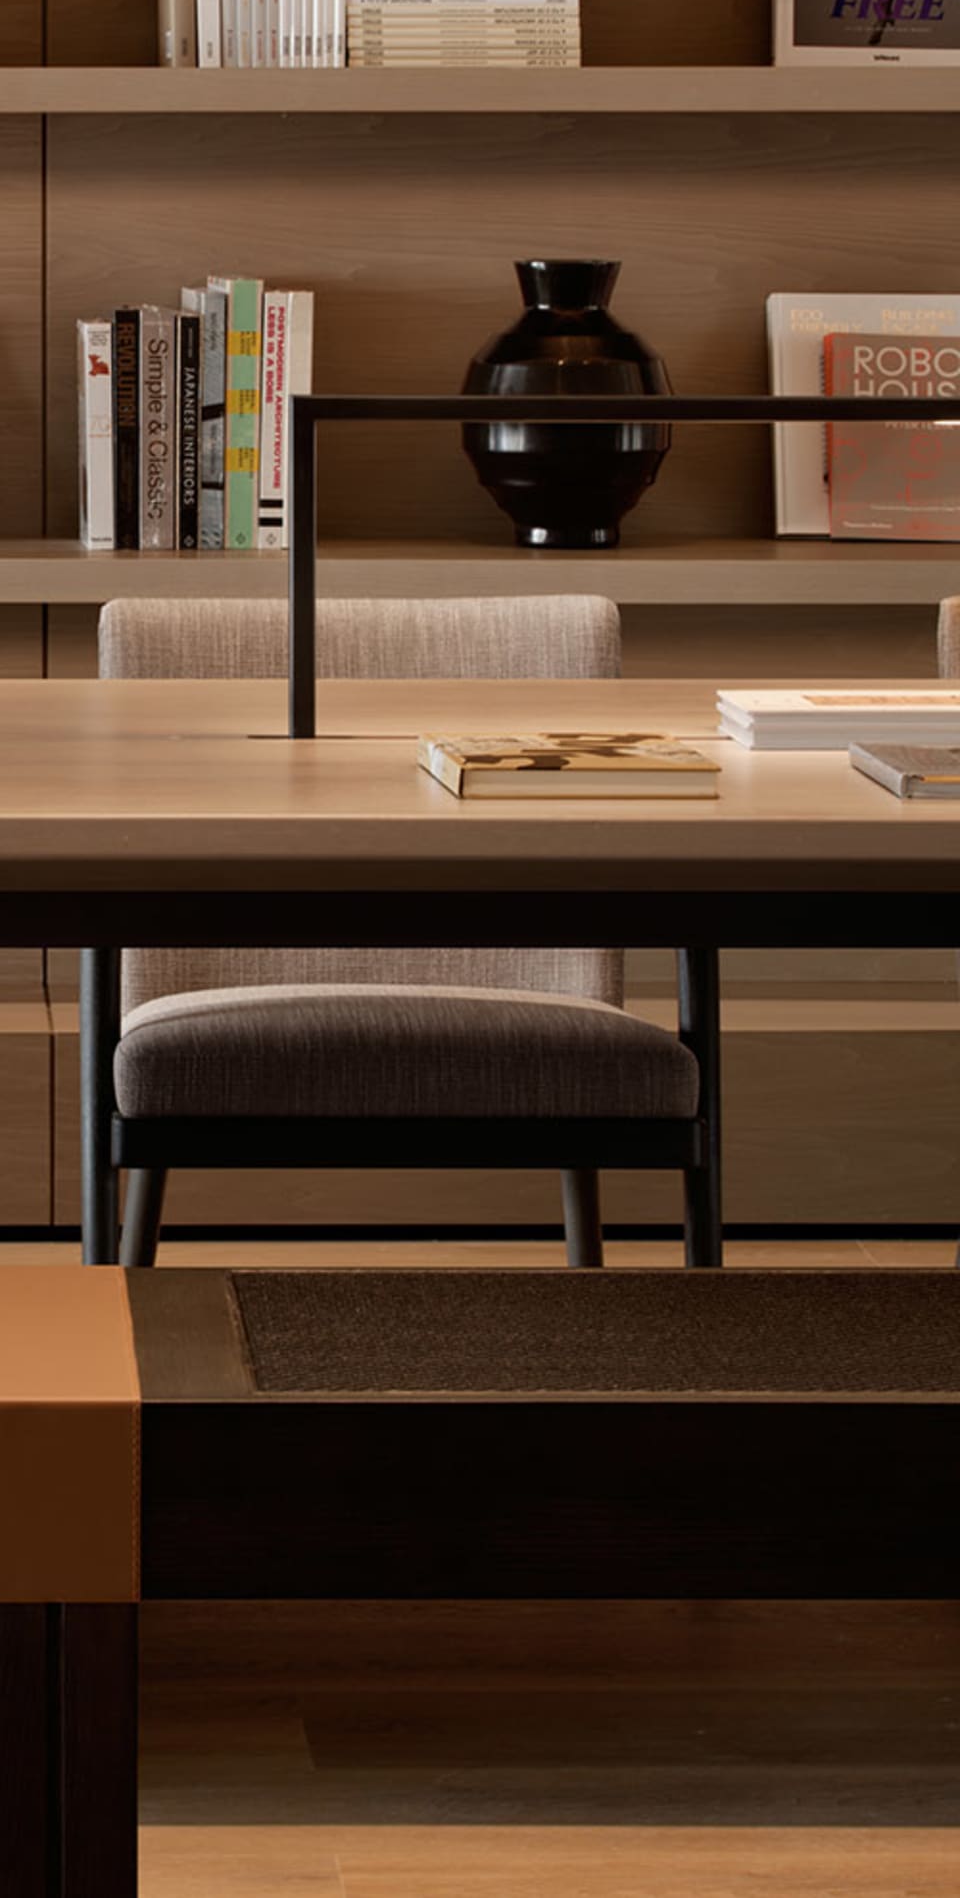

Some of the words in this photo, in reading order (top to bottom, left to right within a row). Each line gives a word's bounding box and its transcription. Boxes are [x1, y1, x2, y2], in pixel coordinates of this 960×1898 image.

[266, 341, 275, 354] IS
[267, 306, 276, 338] LESS
[275, 306, 286, 391] POSTMODERN
[117, 322, 136, 427] REVOLUTION
[145, 338, 168, 417] Simple
[265, 370, 275, 404] BORE
[266, 358, 275, 368] A
[853, 345, 960, 378] ROBO
[149, 419, 168, 436] &
[183, 366, 195, 431] JAPANESE
[183, 437, 195, 505] INTERIORS
[273, 395, 284, 489] ARCHITECTURE
[148, 439, 168, 519] Classic
